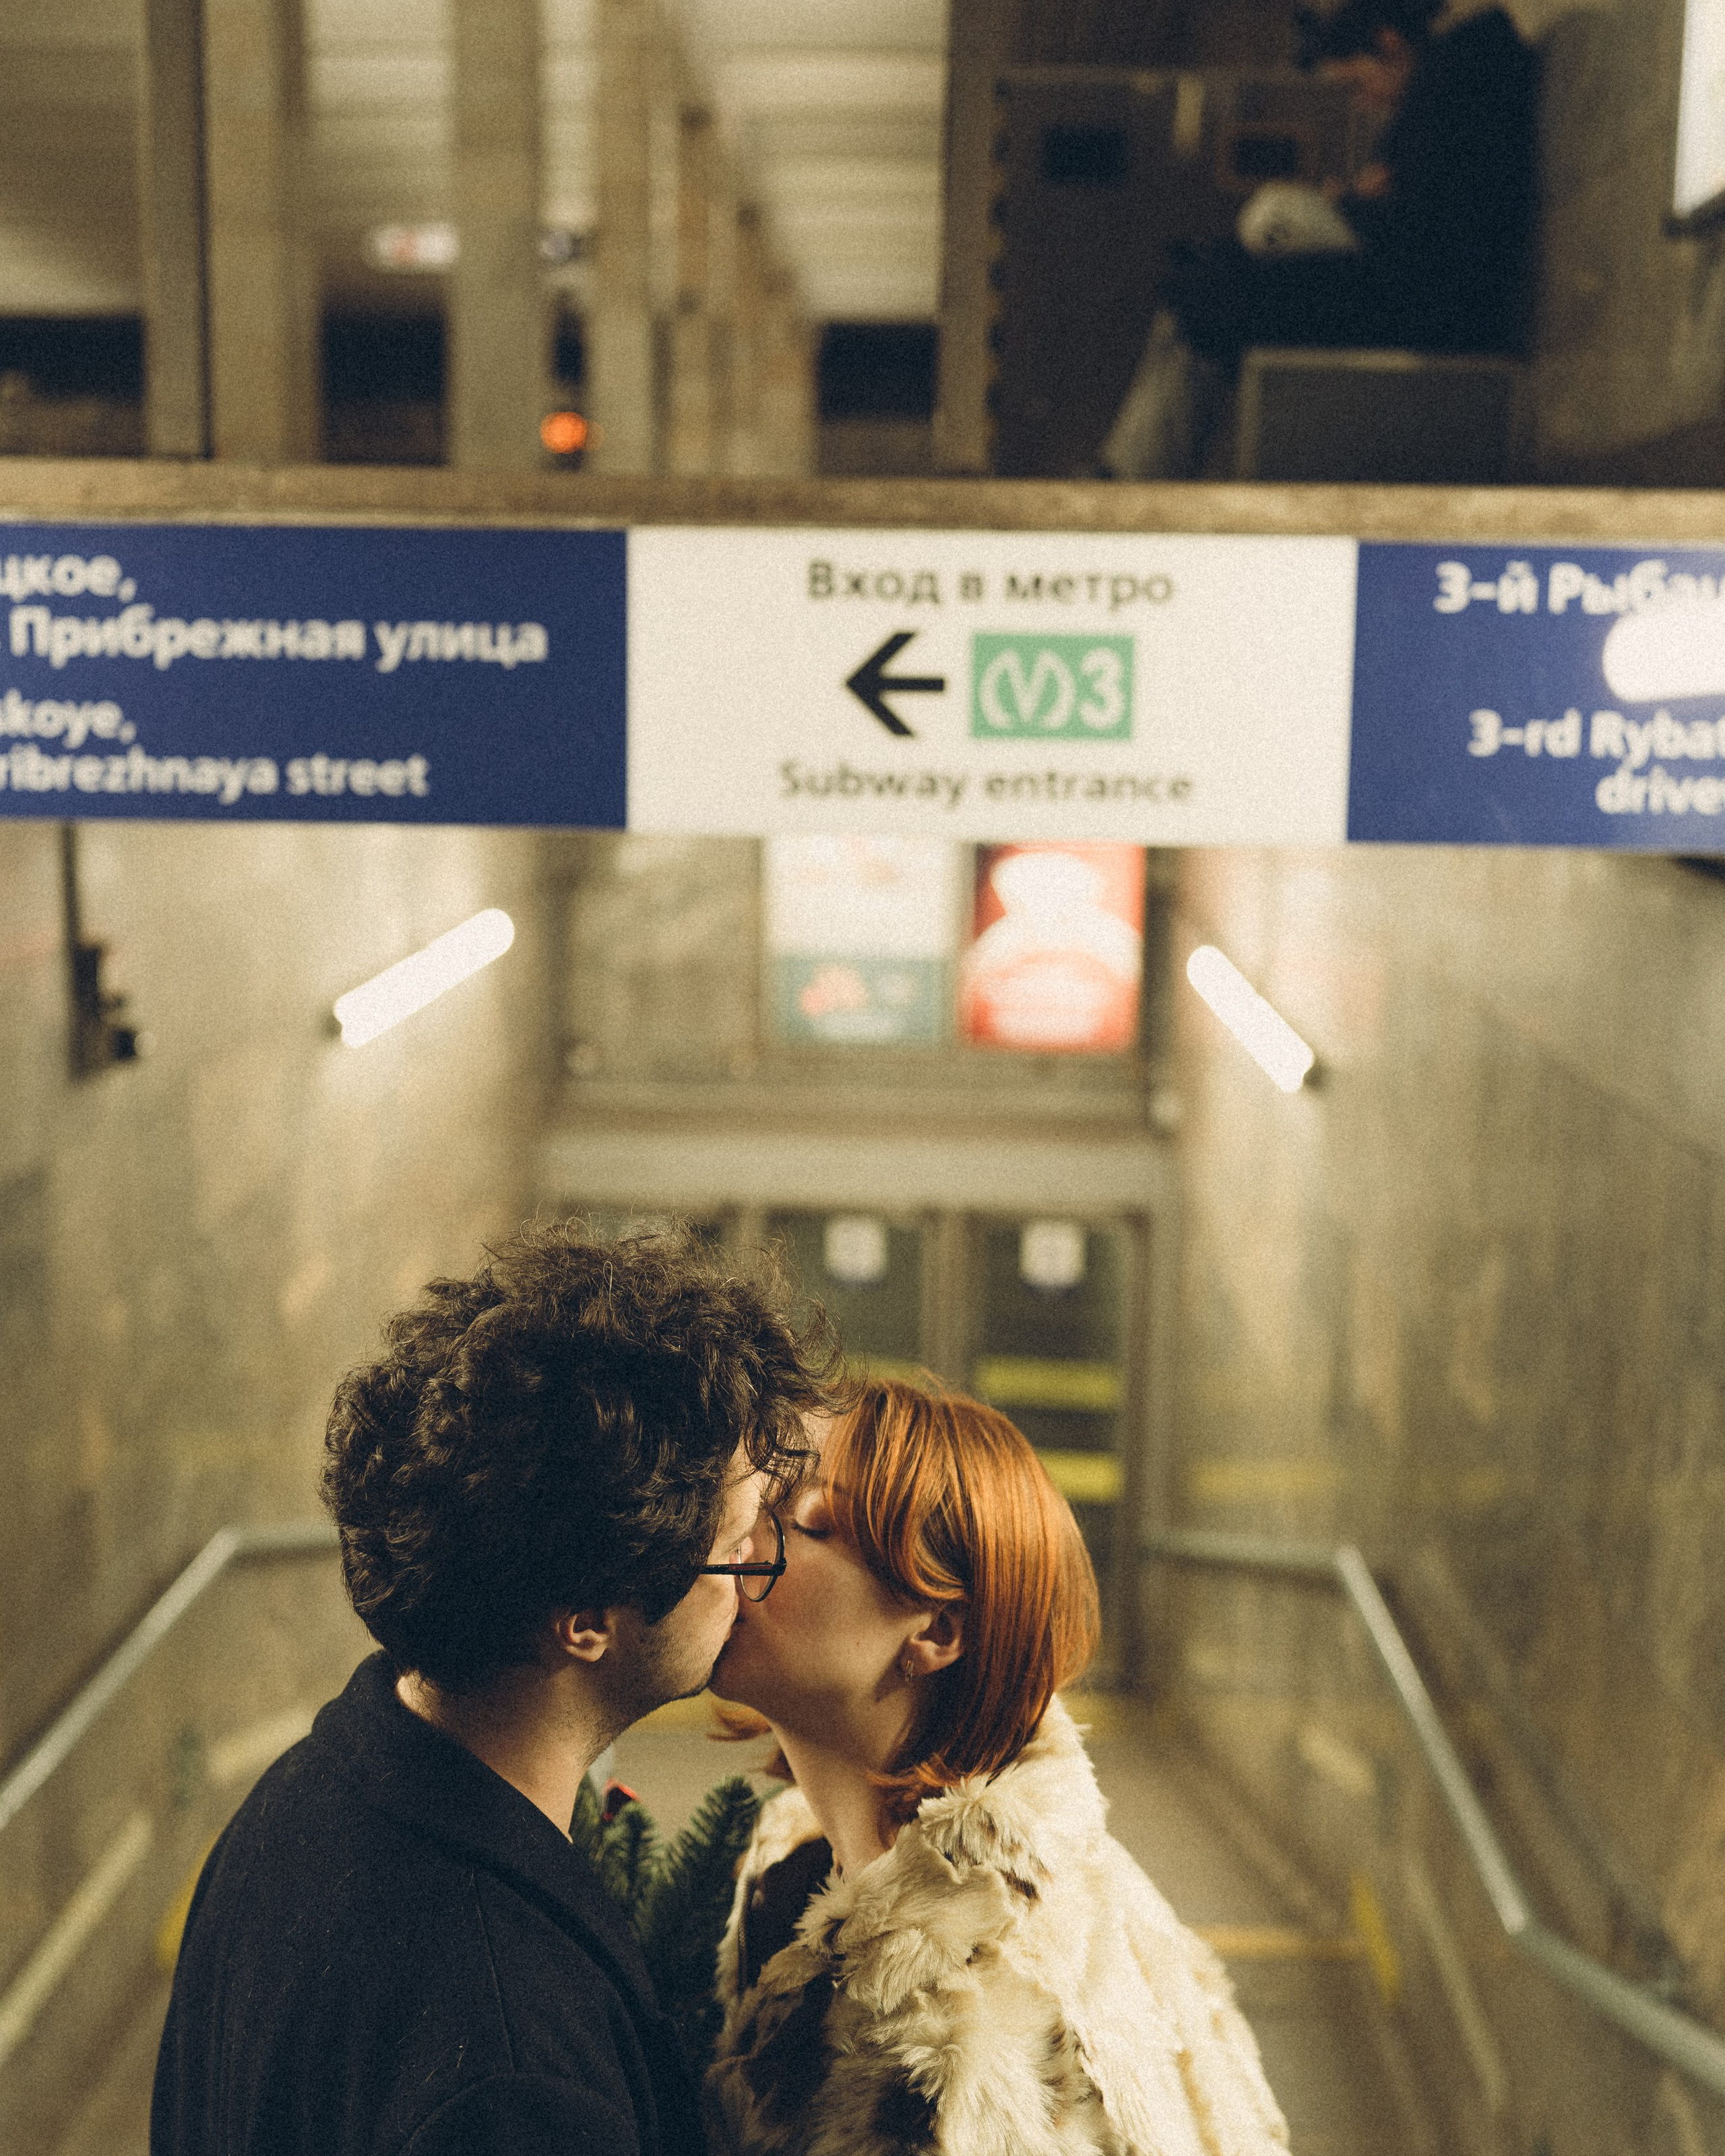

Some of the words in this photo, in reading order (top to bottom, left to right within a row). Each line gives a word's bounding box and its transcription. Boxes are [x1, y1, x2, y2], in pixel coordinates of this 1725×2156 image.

[808, 559, 942, 606] Вход
[959, 570, 985, 602] в
[1005, 571, 1174, 612] метро
[1434, 561, 1539, 614] 3-й
[9, 603, 367, 670] Прибрежная
[374, 621, 548, 672] улица
[0, 687, 136, 749] koye,
[1469, 708, 1582, 757] 3-rd
[286, 753, 429, 796] street
[779, 759, 967, 808] Subway
[984, 768, 1193, 803] entrance
[1594, 764, 1725, 815] drive
